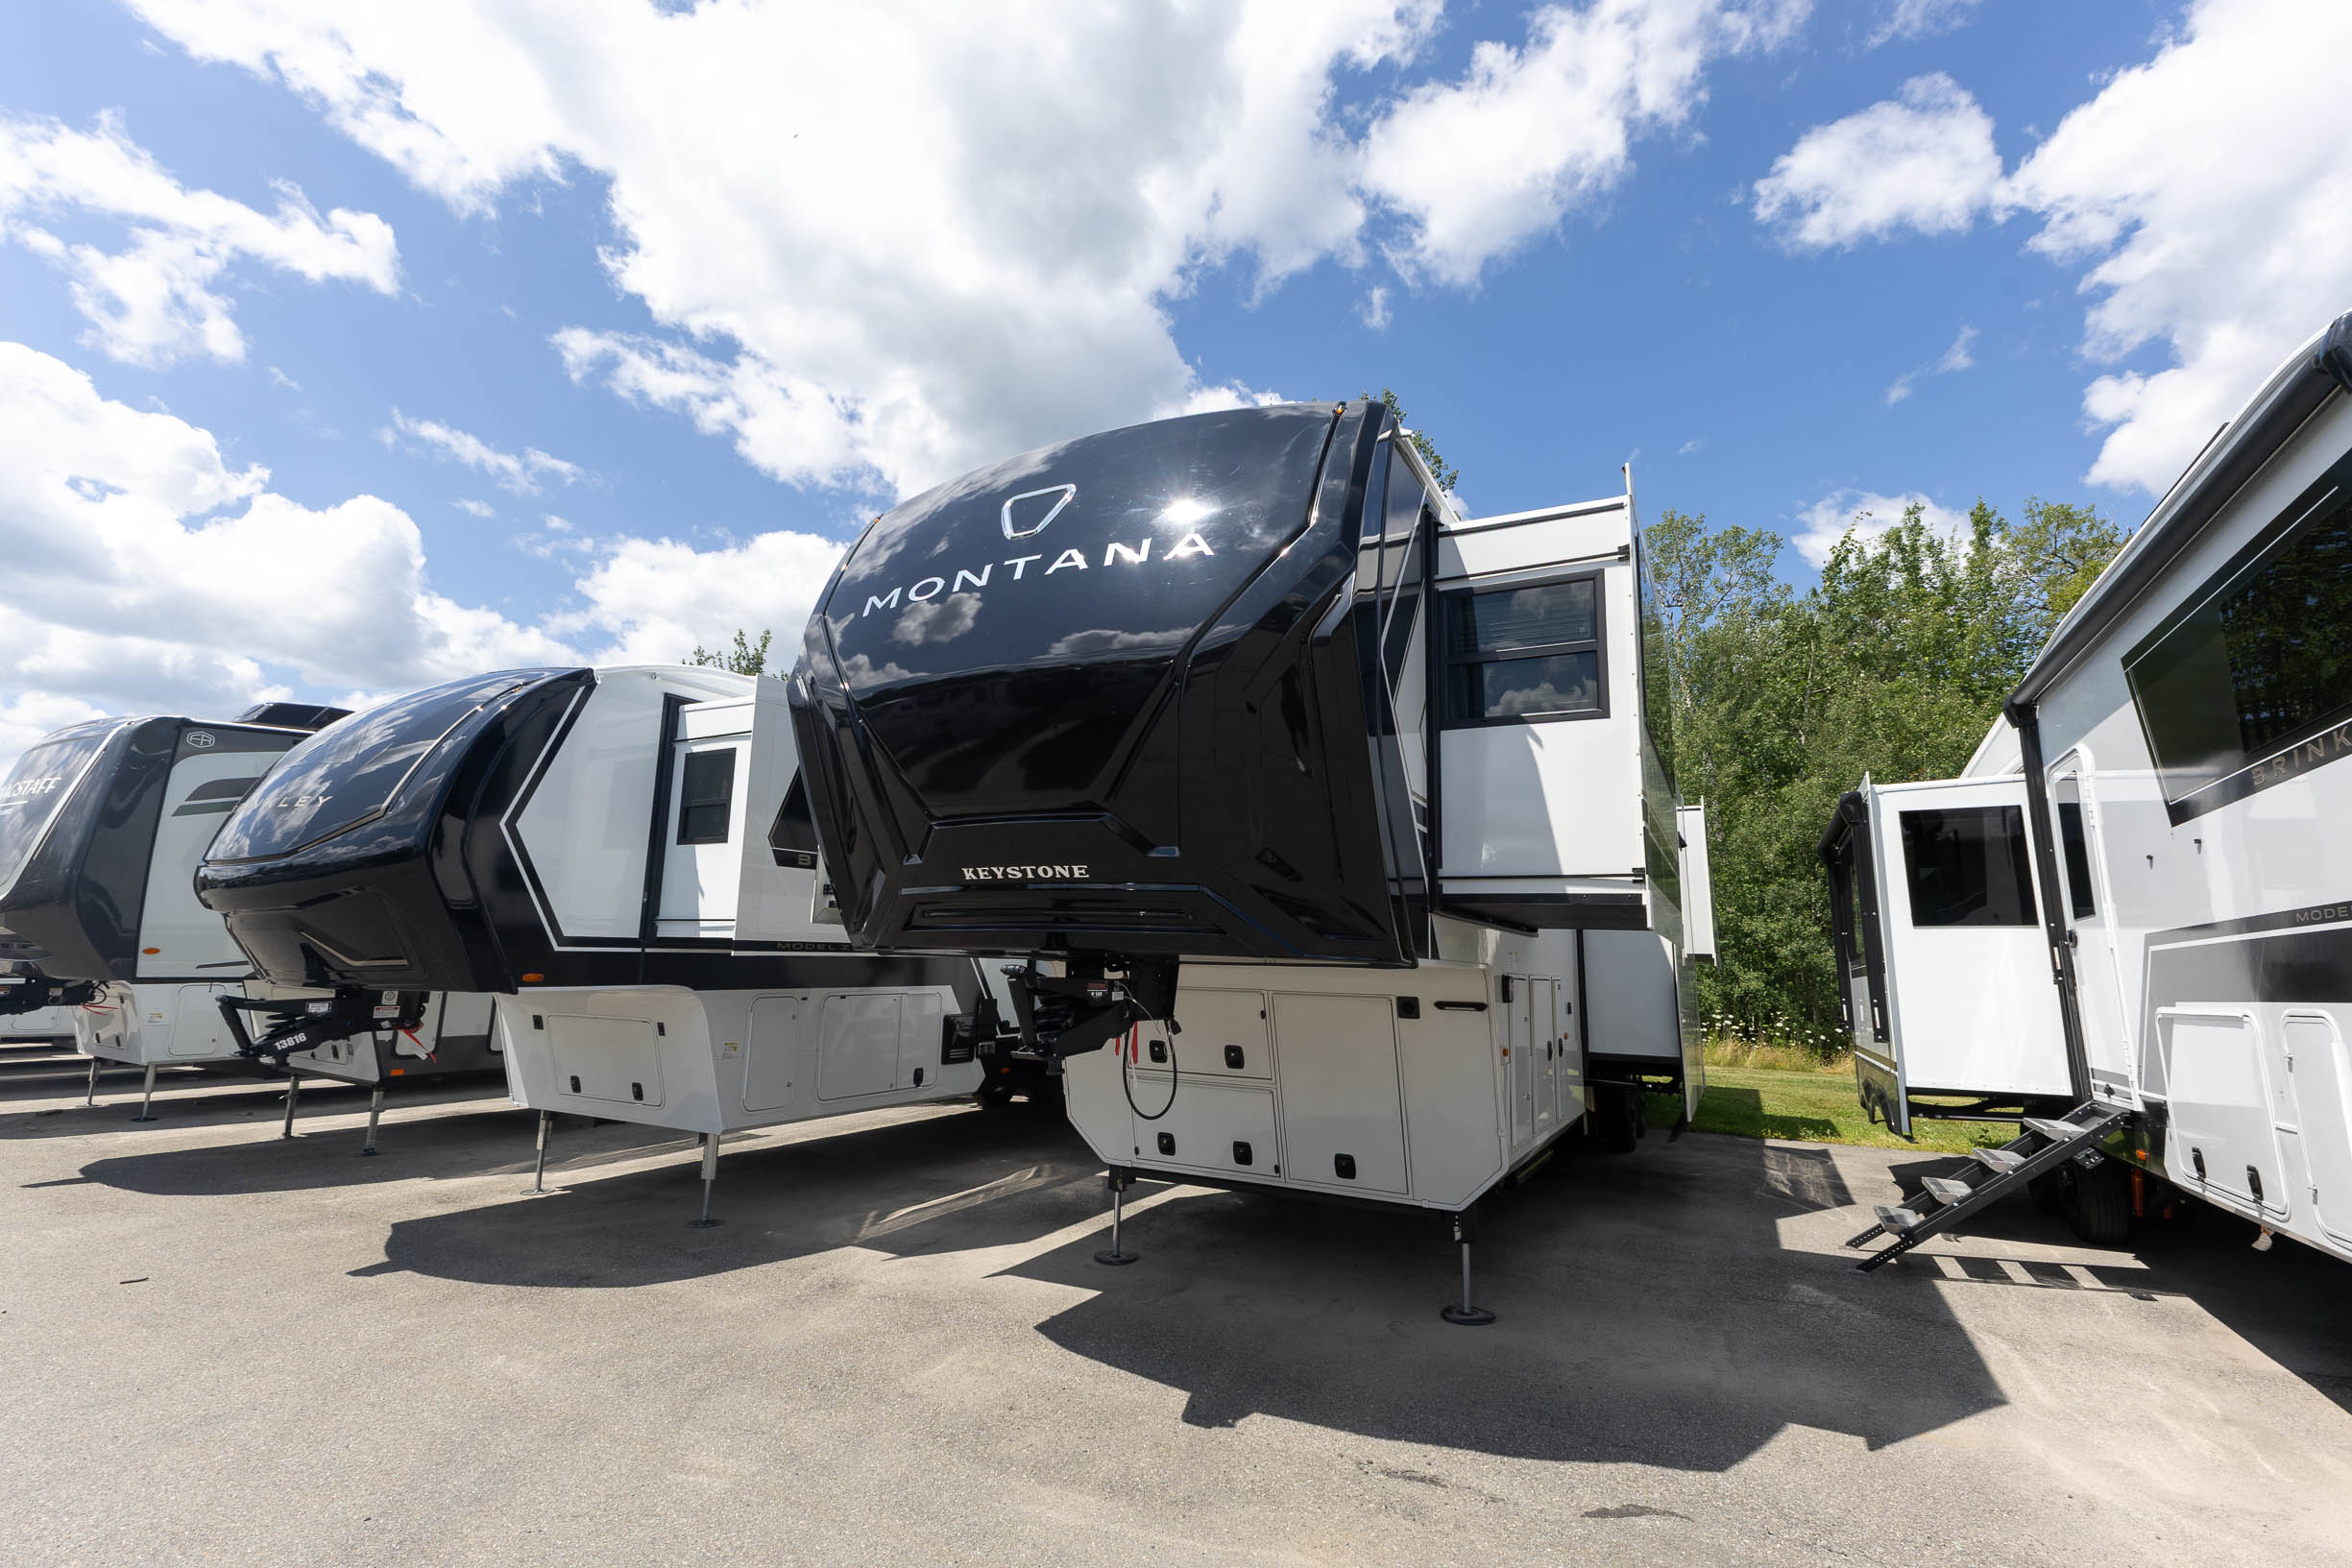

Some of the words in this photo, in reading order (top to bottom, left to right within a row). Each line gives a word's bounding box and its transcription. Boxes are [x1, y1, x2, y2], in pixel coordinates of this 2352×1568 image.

[863, 532, 1214, 616] MONTANA
[961, 864, 1090, 880] KEYSTONE
[2295, 905, 2352, 923] MODE
[776, 942, 837, 952] MODEL
[275, 1032, 307, 1050] 13816
